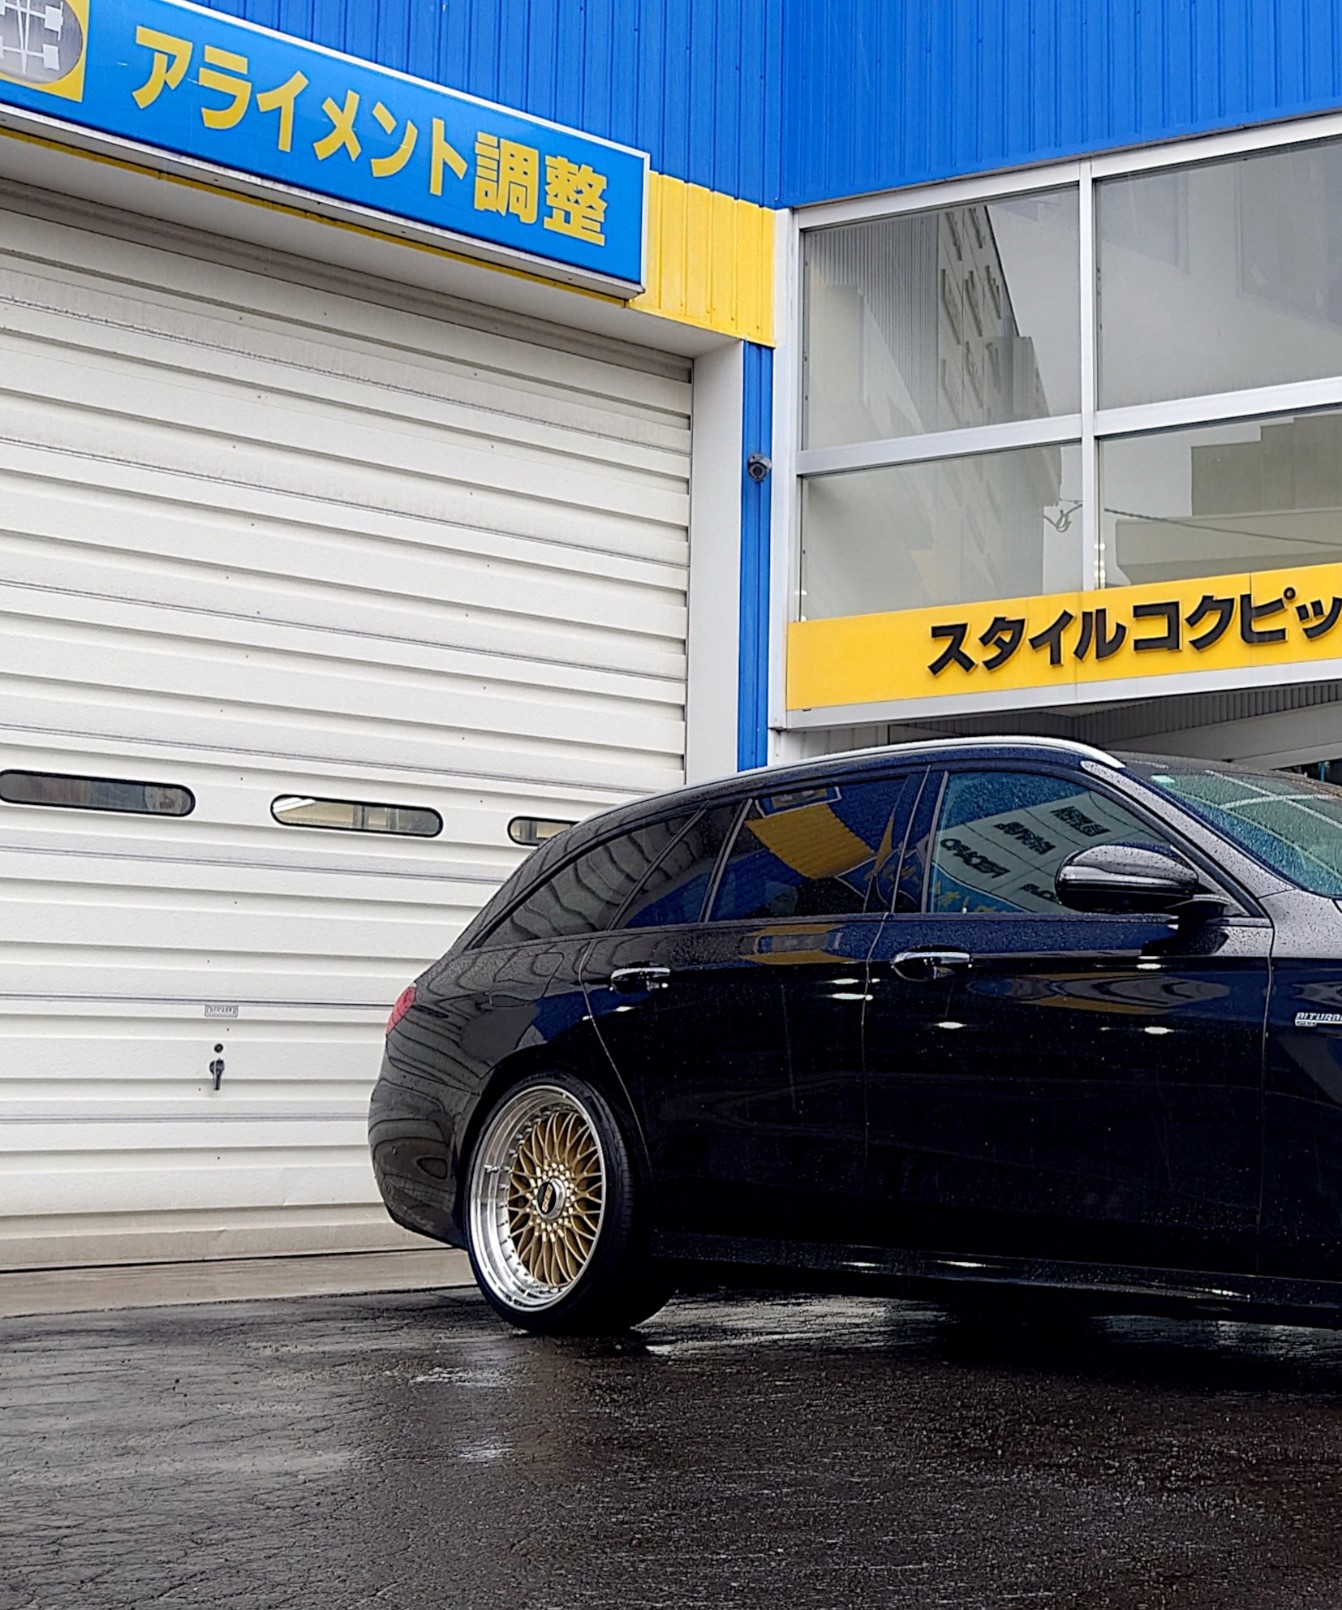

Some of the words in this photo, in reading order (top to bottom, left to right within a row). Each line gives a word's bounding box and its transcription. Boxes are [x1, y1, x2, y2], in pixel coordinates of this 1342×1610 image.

[130, 25, 608, 247] アライメント調整
